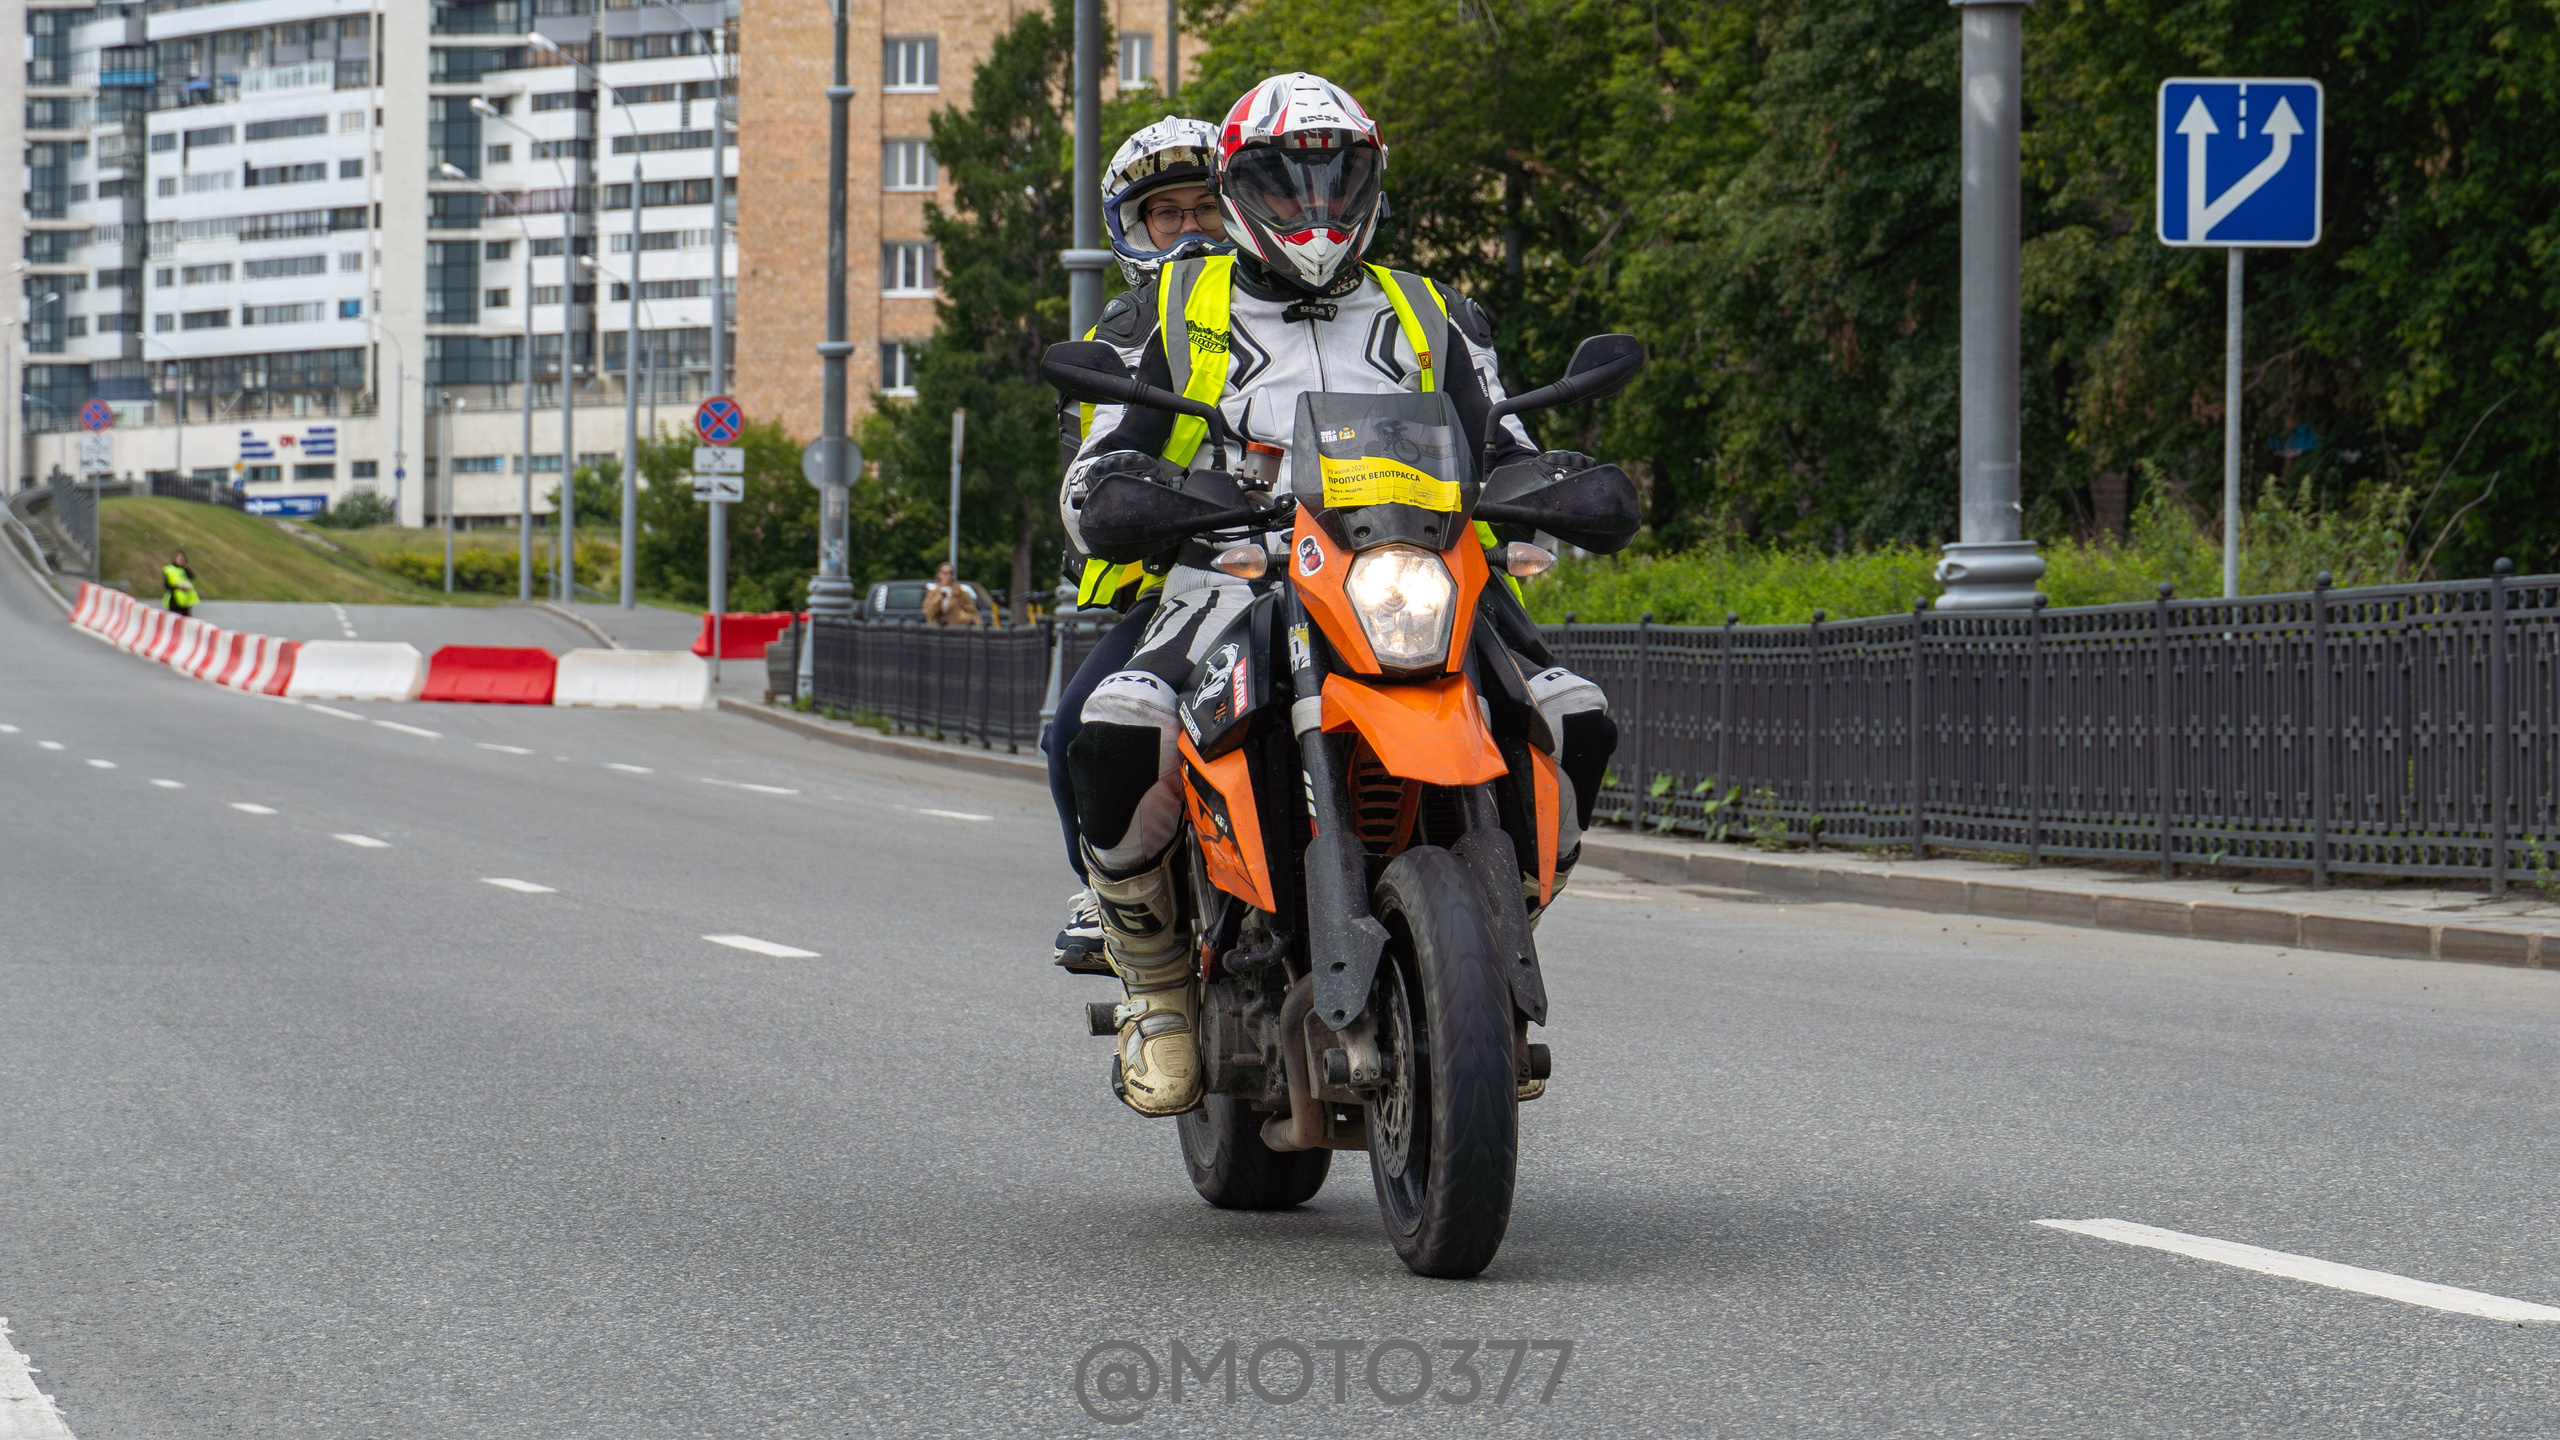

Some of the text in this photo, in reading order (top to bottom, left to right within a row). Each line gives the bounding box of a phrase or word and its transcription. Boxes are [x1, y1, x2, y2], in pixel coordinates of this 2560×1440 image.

[1321, 434, 1338, 443] STAR
[1351, 464, 1366, 473] 2025
[1328, 470, 1421, 485] ПРОПУСК ВЕЛОТРАССА
[1235, 663, 1246, 714] MOTUL
